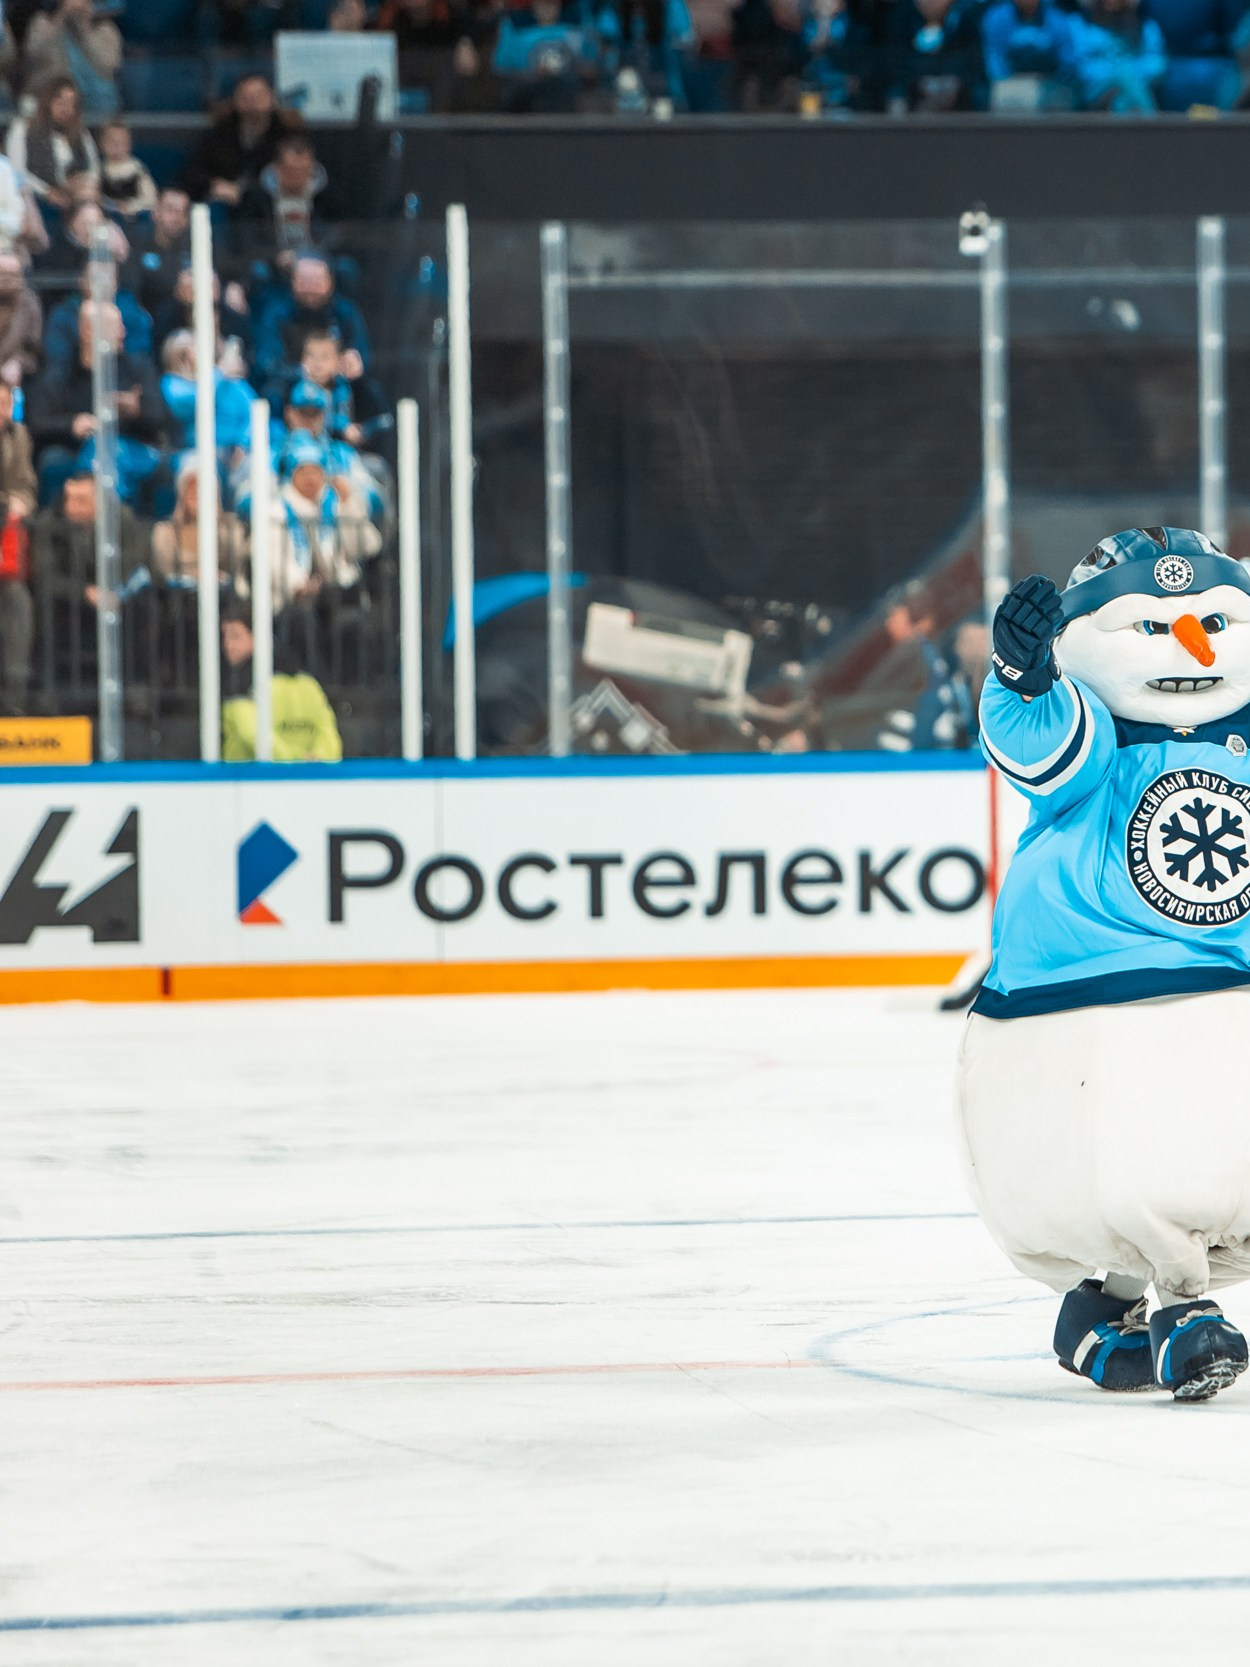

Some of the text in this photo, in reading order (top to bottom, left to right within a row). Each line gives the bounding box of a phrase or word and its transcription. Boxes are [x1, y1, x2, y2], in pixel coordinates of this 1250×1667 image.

[1130, 772, 1188, 849] ХОККЕЙНЫЙ
[1191, 772, 1229, 793] КЛУБ
[326, 828, 986, 922] Ростелеко
[1133, 861, 1240, 922] НОВОСИБИРСКАЯ
